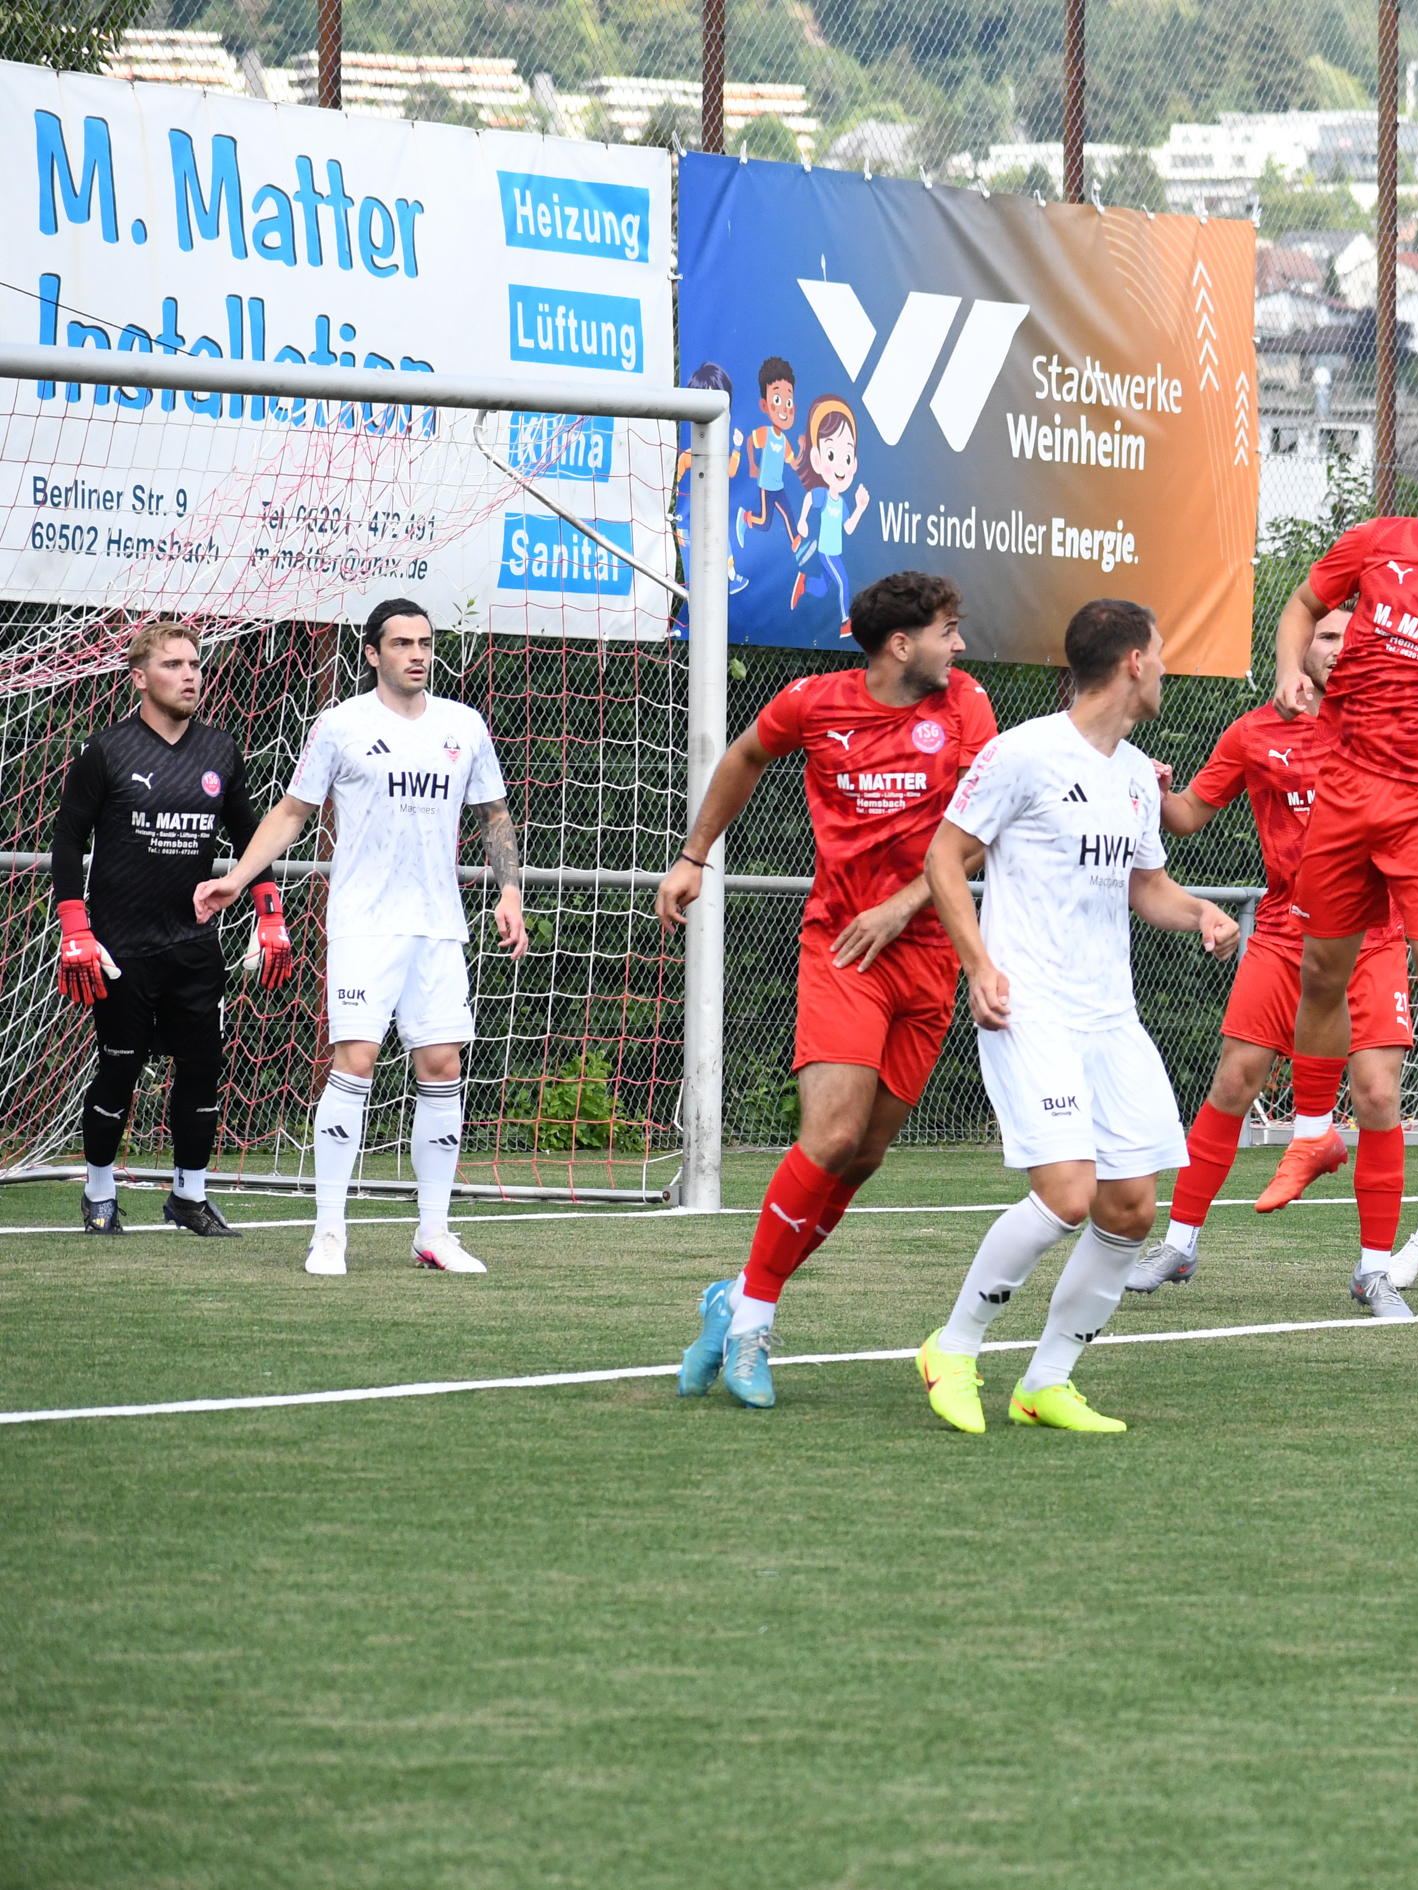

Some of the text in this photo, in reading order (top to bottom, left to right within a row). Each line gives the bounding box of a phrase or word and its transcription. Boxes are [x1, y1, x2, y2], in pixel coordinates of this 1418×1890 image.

[34, 108, 425, 279] M. Matter
[515, 188, 641, 260] Heizung
[37, 272, 436, 438] Installation
[518, 302, 636, 370] Lüftung
[1031, 354, 1183, 414] Stadtwerke
[517, 415, 604, 469] Klima
[1006, 412, 1146, 471] Weinheim
[32, 475, 188, 518] Berliner Str. 9
[31, 521, 219, 564] 69502 Hemsbach
[879, 501, 1139, 573] Wir sind voller Energie.
[1373, 602, 1393, 628] M.
[388, 771, 450, 800] HWH
[837, 772, 927, 790] M. MATTER
[1287, 791, 1304, 806] M.
[131, 811, 215, 830] M. MATTER
[1079, 834, 1137, 868] HWH
[336, 989, 368, 1006] BUK
[1039, 1096, 1081, 1113] BUK
